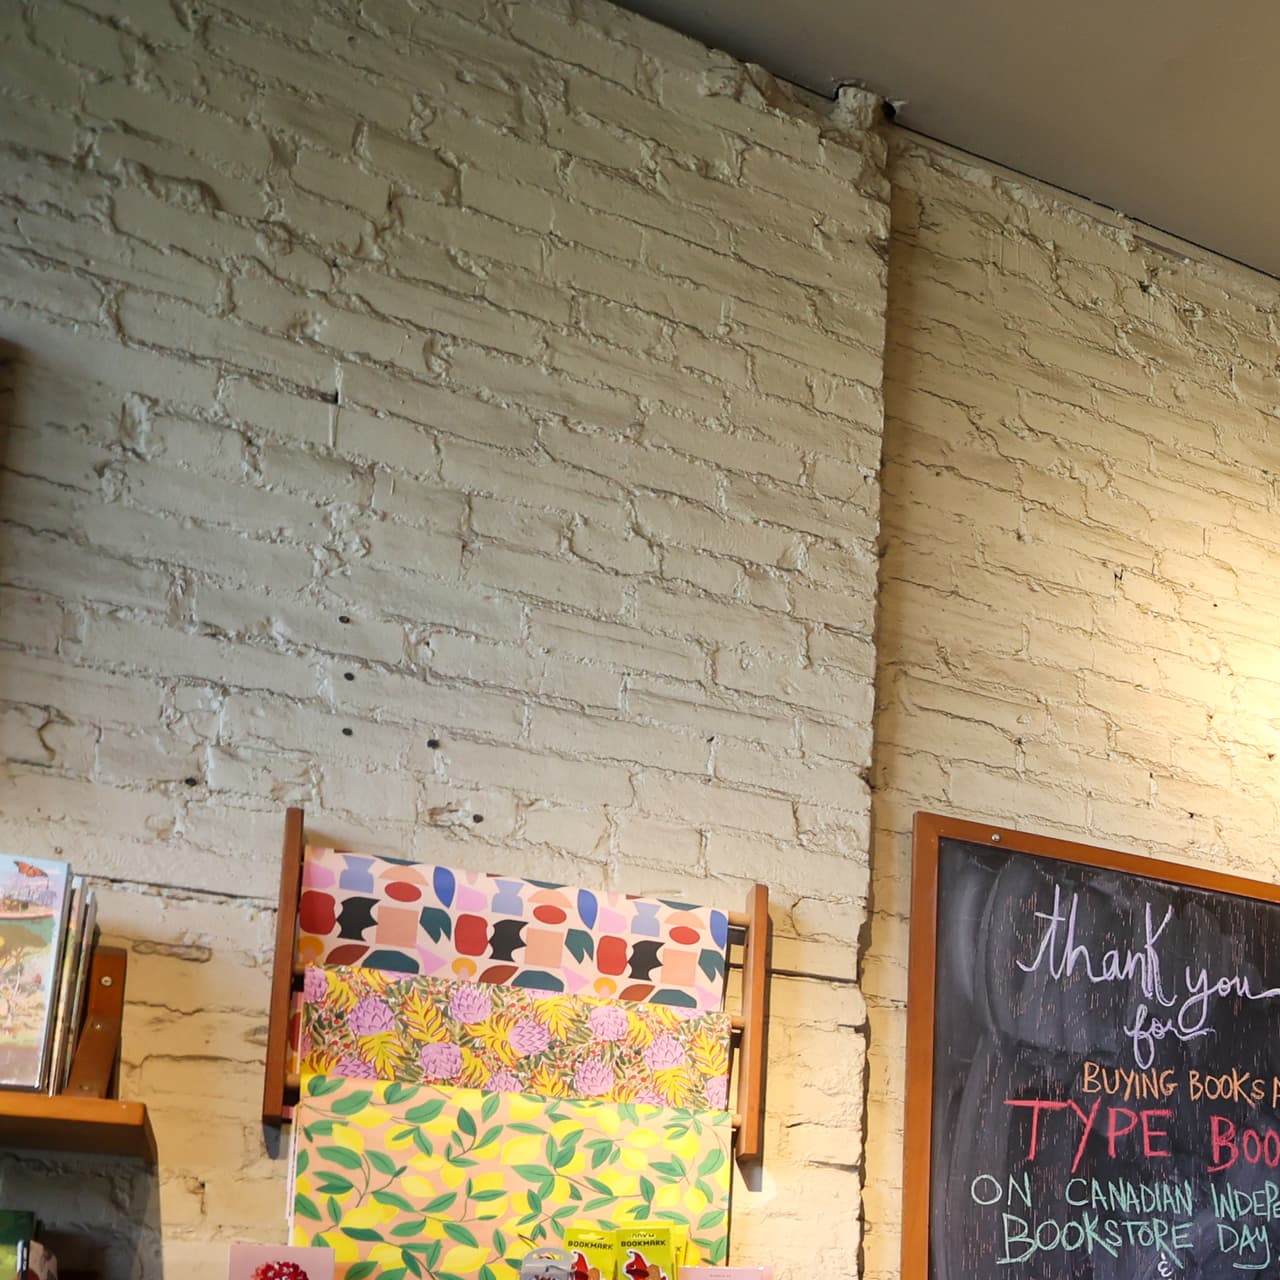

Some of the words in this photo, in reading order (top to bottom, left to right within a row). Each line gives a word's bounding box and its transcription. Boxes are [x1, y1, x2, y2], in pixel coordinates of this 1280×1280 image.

[1016, 883, 1175, 1006] thank
[1126, 1004, 1215, 1070] for
[1082, 1061, 1178, 1099] BUYING
[1189, 1069, 1264, 1108] BOOKS
[1003, 1099, 1173, 1173] TYPE
[971, 1172, 1032, 1209] ON
[1066, 1176, 1194, 1217] CANADIAN
[567, 1239, 614, 1251] BOOKMARK
[620, 1239, 667, 1248] BOOKMARK
[996, 1211, 1195, 1268] BOOKSTORE
[1216, 1222, 1272, 1270] DAY
